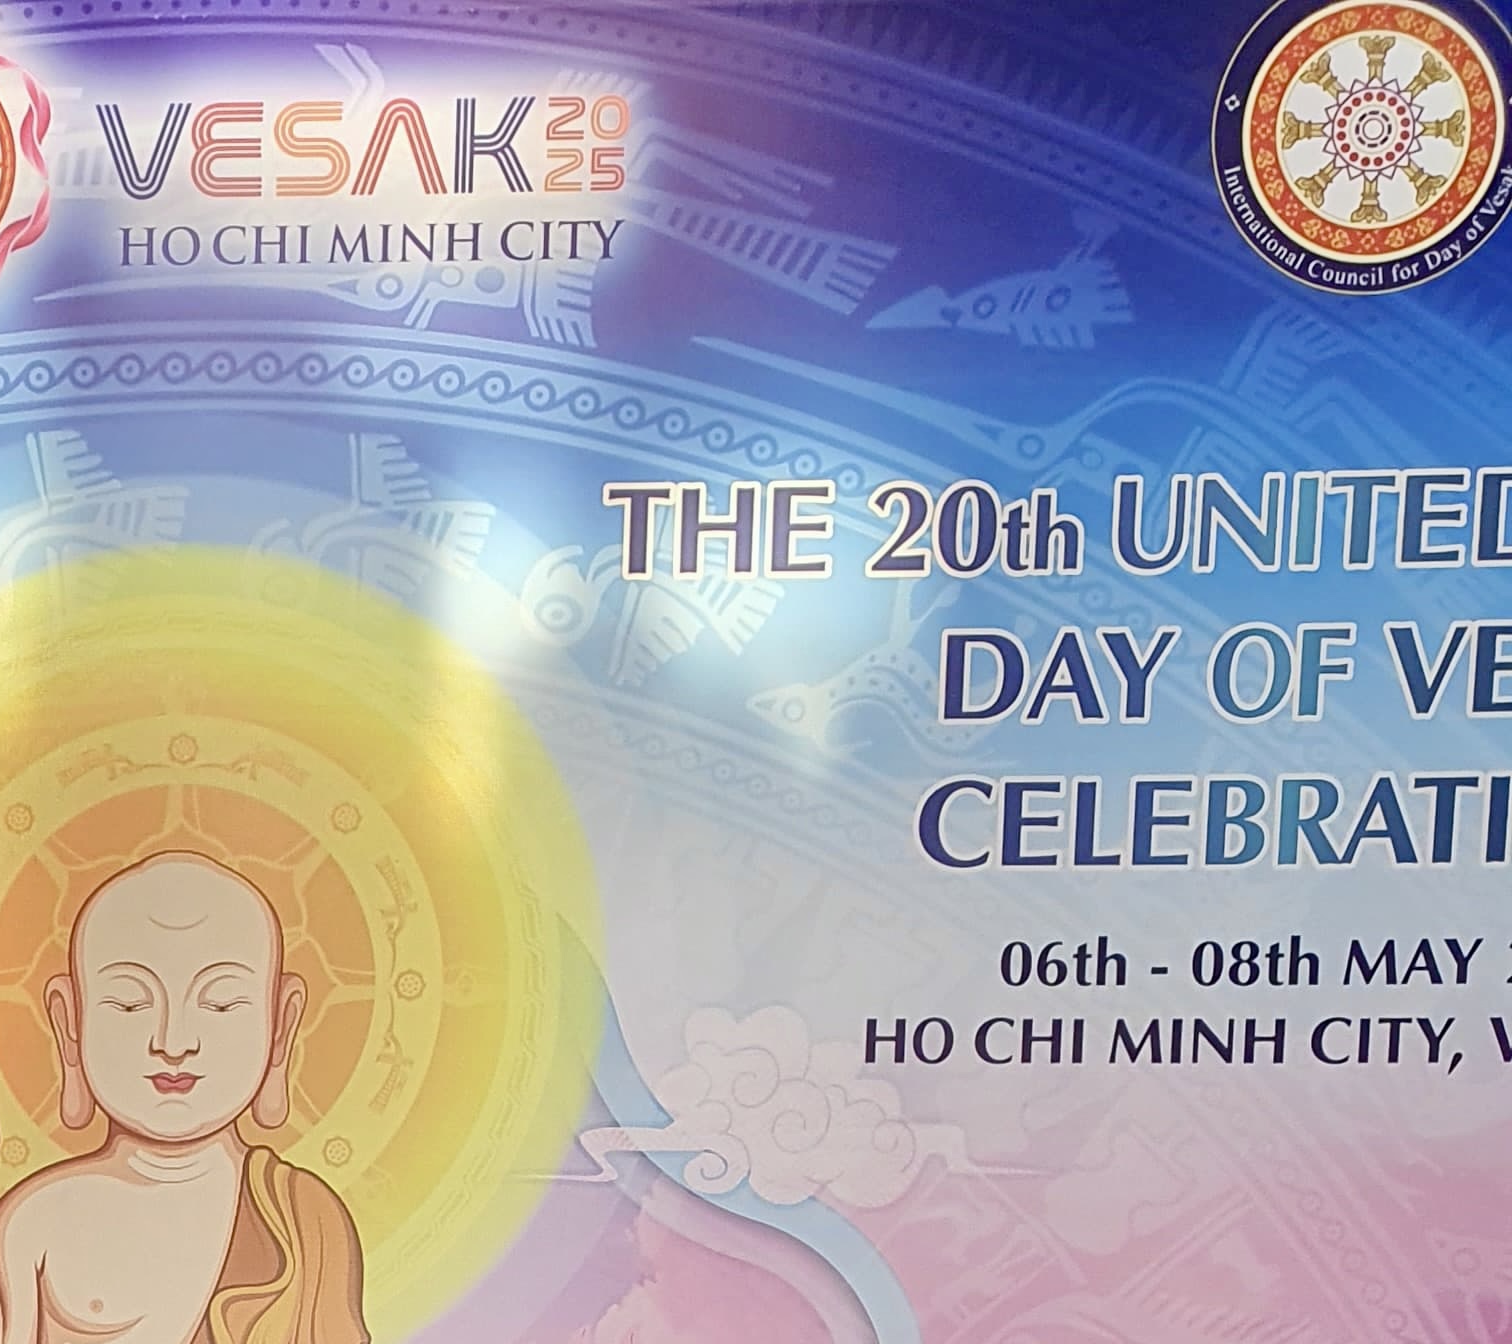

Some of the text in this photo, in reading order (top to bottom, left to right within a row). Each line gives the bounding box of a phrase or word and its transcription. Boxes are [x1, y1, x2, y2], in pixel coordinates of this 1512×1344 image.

[97, 97, 536, 199] VESAK
[119, 219, 625, 266] HO CHI MINH CITY
[1224, 165, 1306, 271] International
[1307, 259, 1384, 286] Council
[1390, 262, 1420, 283] for
[1424, 238, 1462, 274] Day
[1466, 215, 1485, 242] of
[602, 478, 834, 581] THE
[866, 478, 1084, 579] 20th
[940, 626, 1180, 725] DAY
[1208, 622, 1356, 722] OF
[1000, 936, 1128, 987] 06th
[1190, 934, 1320, 987] 08th
[1344, 937, 1484, 985] MAY
[865, 1017, 954, 1066] HO
[973, 1016, 1085, 1065] CHI
[1110, 1016, 1287, 1065] MINH
[1309, 1016, 1463, 1075] CITY,
